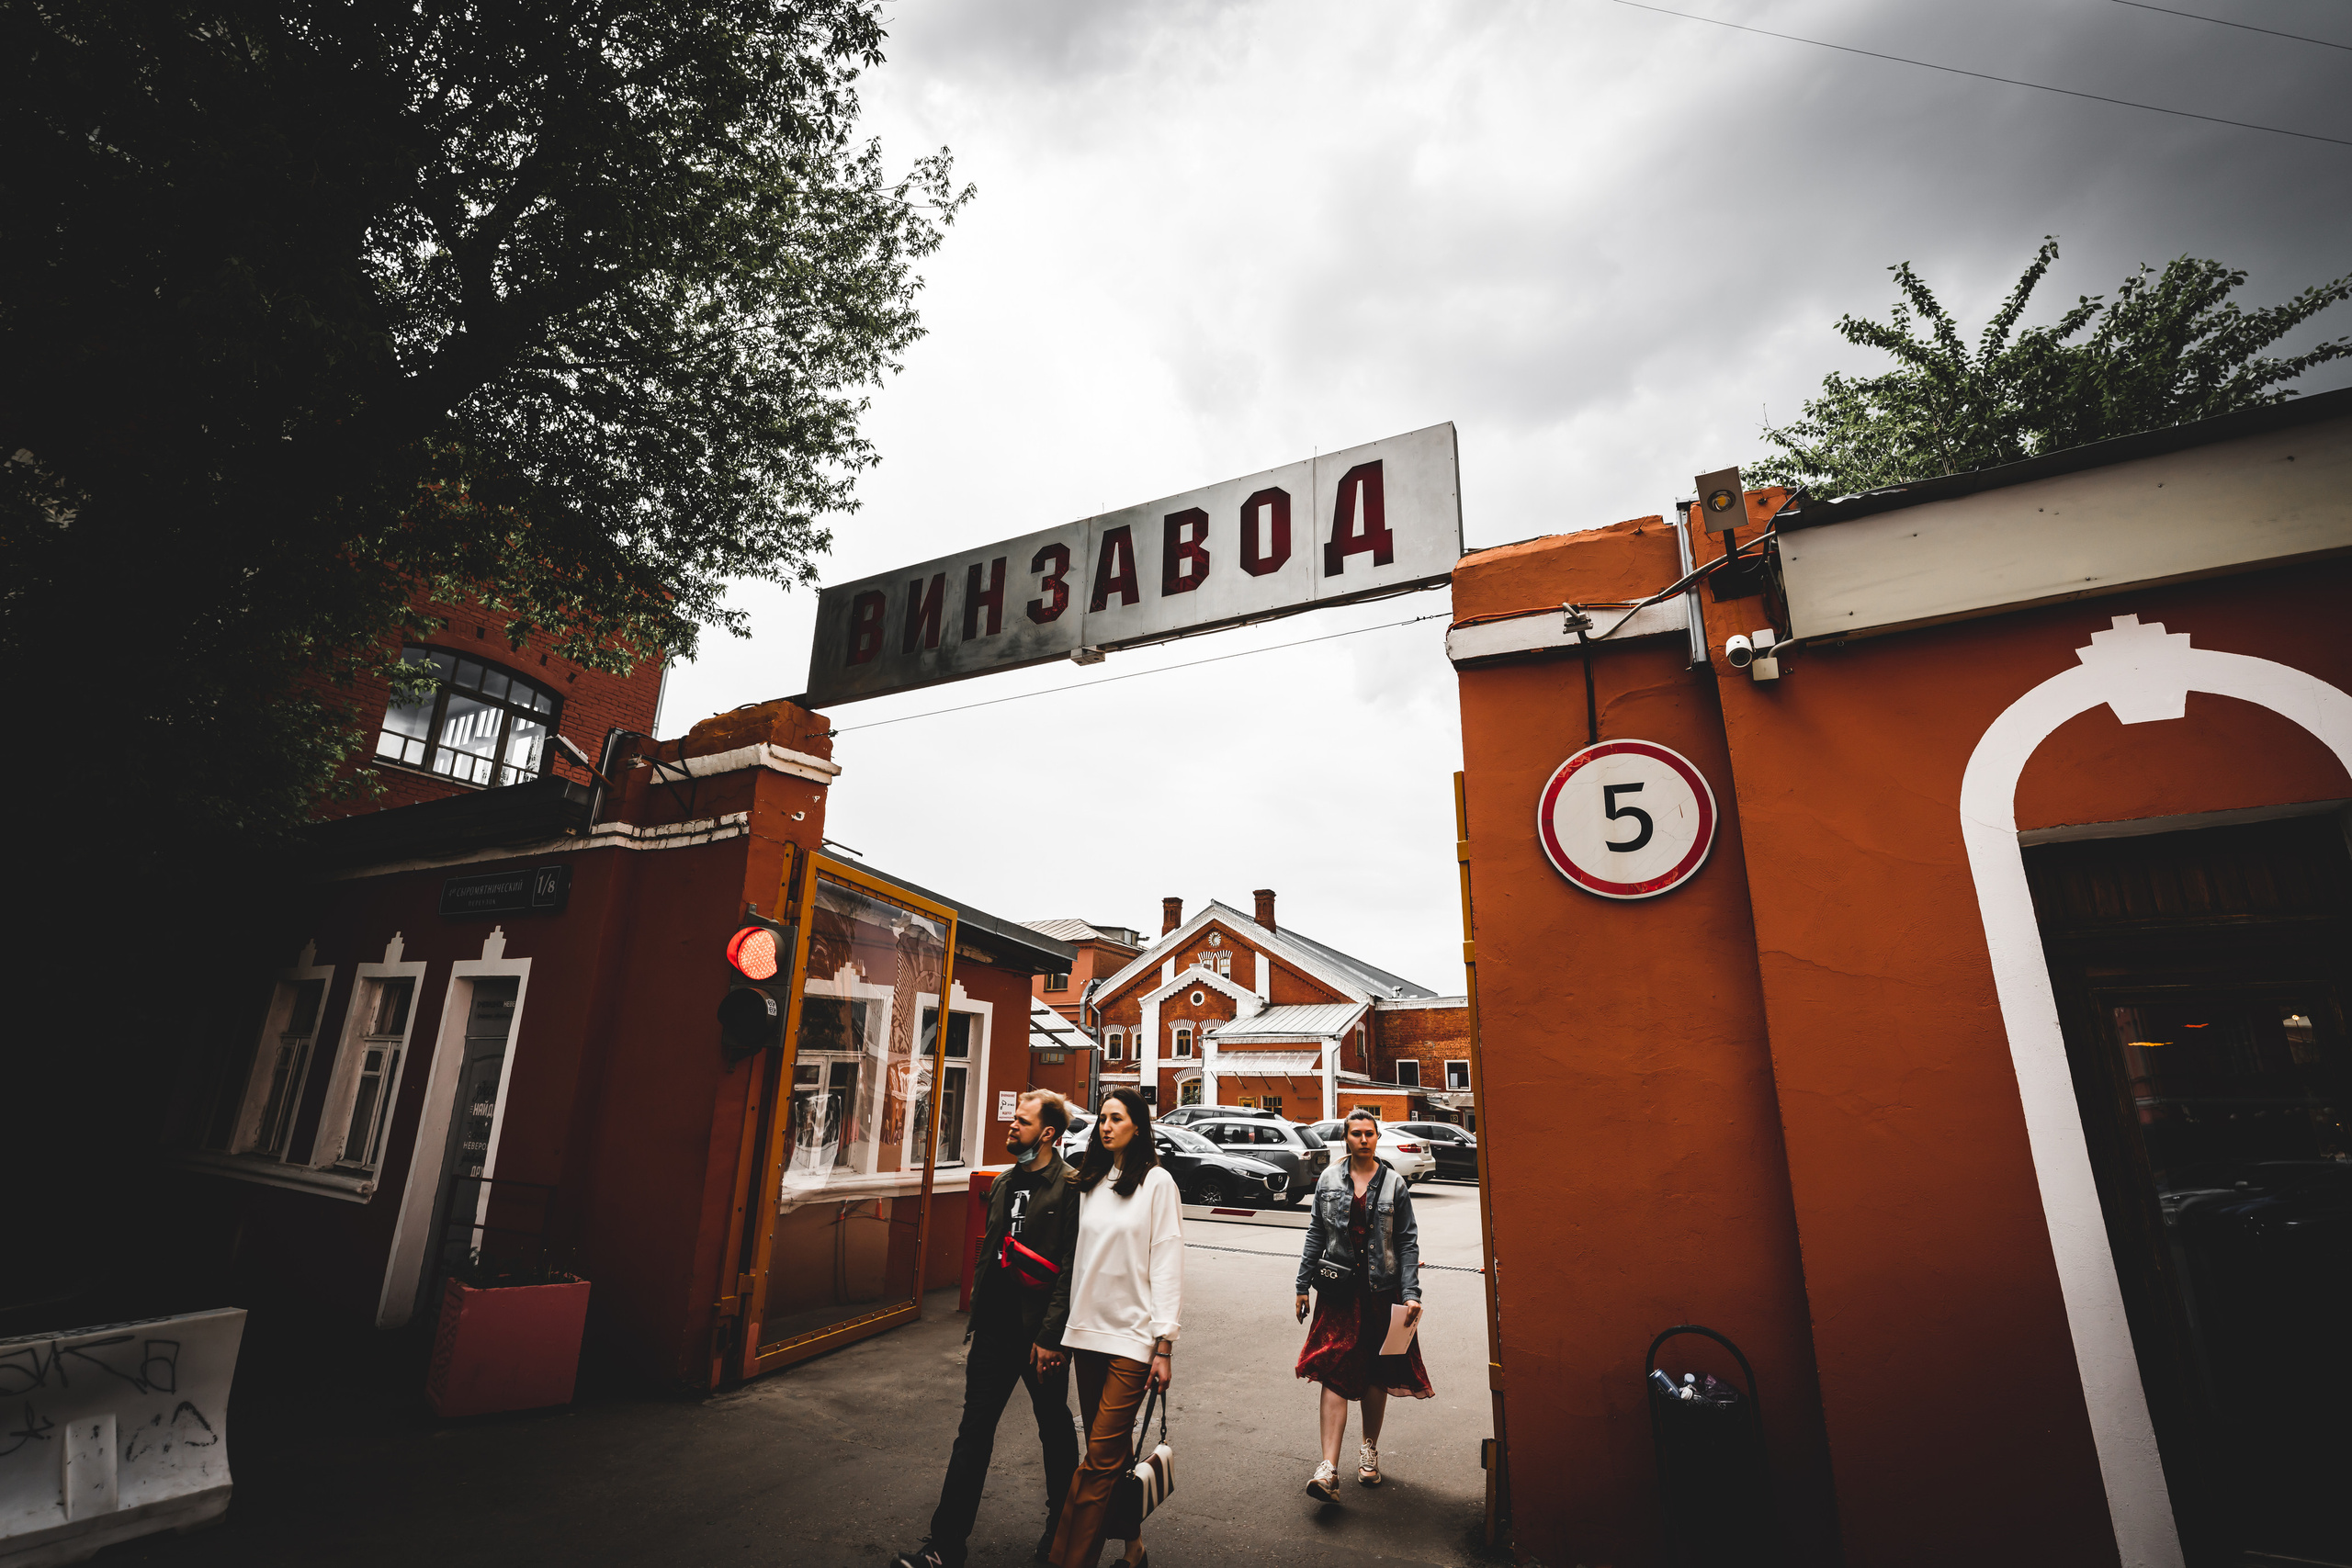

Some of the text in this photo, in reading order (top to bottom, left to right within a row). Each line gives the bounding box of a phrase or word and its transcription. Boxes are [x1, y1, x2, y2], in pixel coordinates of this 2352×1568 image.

[845, 458, 1395, 667] ВИНЗАВОД
[1603, 782, 1654, 852] 5
[457, 880, 524, 897] СЫРОМЯТНИЧЕСКИЙ
[537, 873, 556, 897] 1/8
[472, 1100, 494, 1118] НАЙД
[462, 1141, 488, 1151] НЕВЕРО
